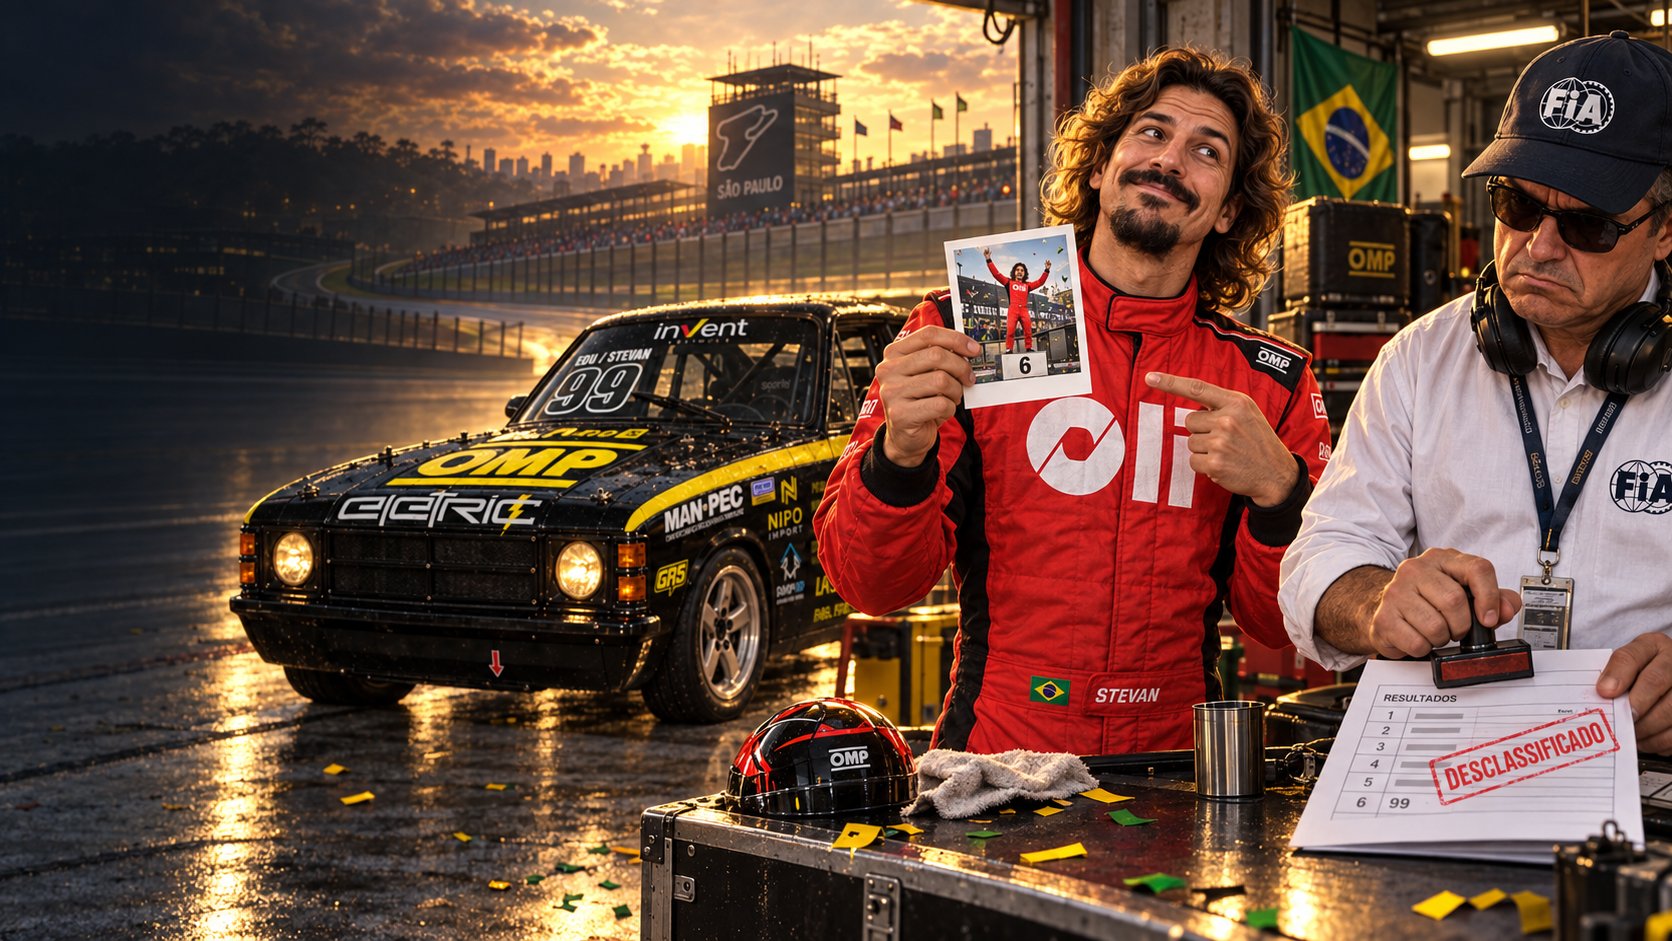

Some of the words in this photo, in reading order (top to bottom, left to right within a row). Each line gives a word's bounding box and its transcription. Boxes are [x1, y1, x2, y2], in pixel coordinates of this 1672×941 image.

[717, 176, 740, 200] SÃO
[744, 175, 783, 195] PAULO
[1348, 247, 1396, 267] OMP
[575, 354, 597, 367] EDU
[608, 348, 652, 363] STEVAN
[1020, 356, 1032, 374] 6
[1258, 350, 1290, 369] OMP
[544, 363, 643, 415] 99
[417, 448, 618, 477] OMP
[768, 507, 803, 531] NIPO
[768, 525, 803, 541] IMPORT
[1095, 687, 1160, 704] STEVAN
[1383, 693, 1458, 703] RESULTADOS
[1388, 711, 1394, 720] 1
[1381, 726, 1391, 735] 2
[1376, 742, 1385, 751] 3
[830, 749, 869, 766] OMP
[1370, 759, 1379, 769] 4
[1444, 722, 1606, 791] DESCLASSIFICADO
[1363, 777, 1373, 787] 5
[1356, 797, 1367, 808] 6
[1389, 797, 1410, 809] 99
